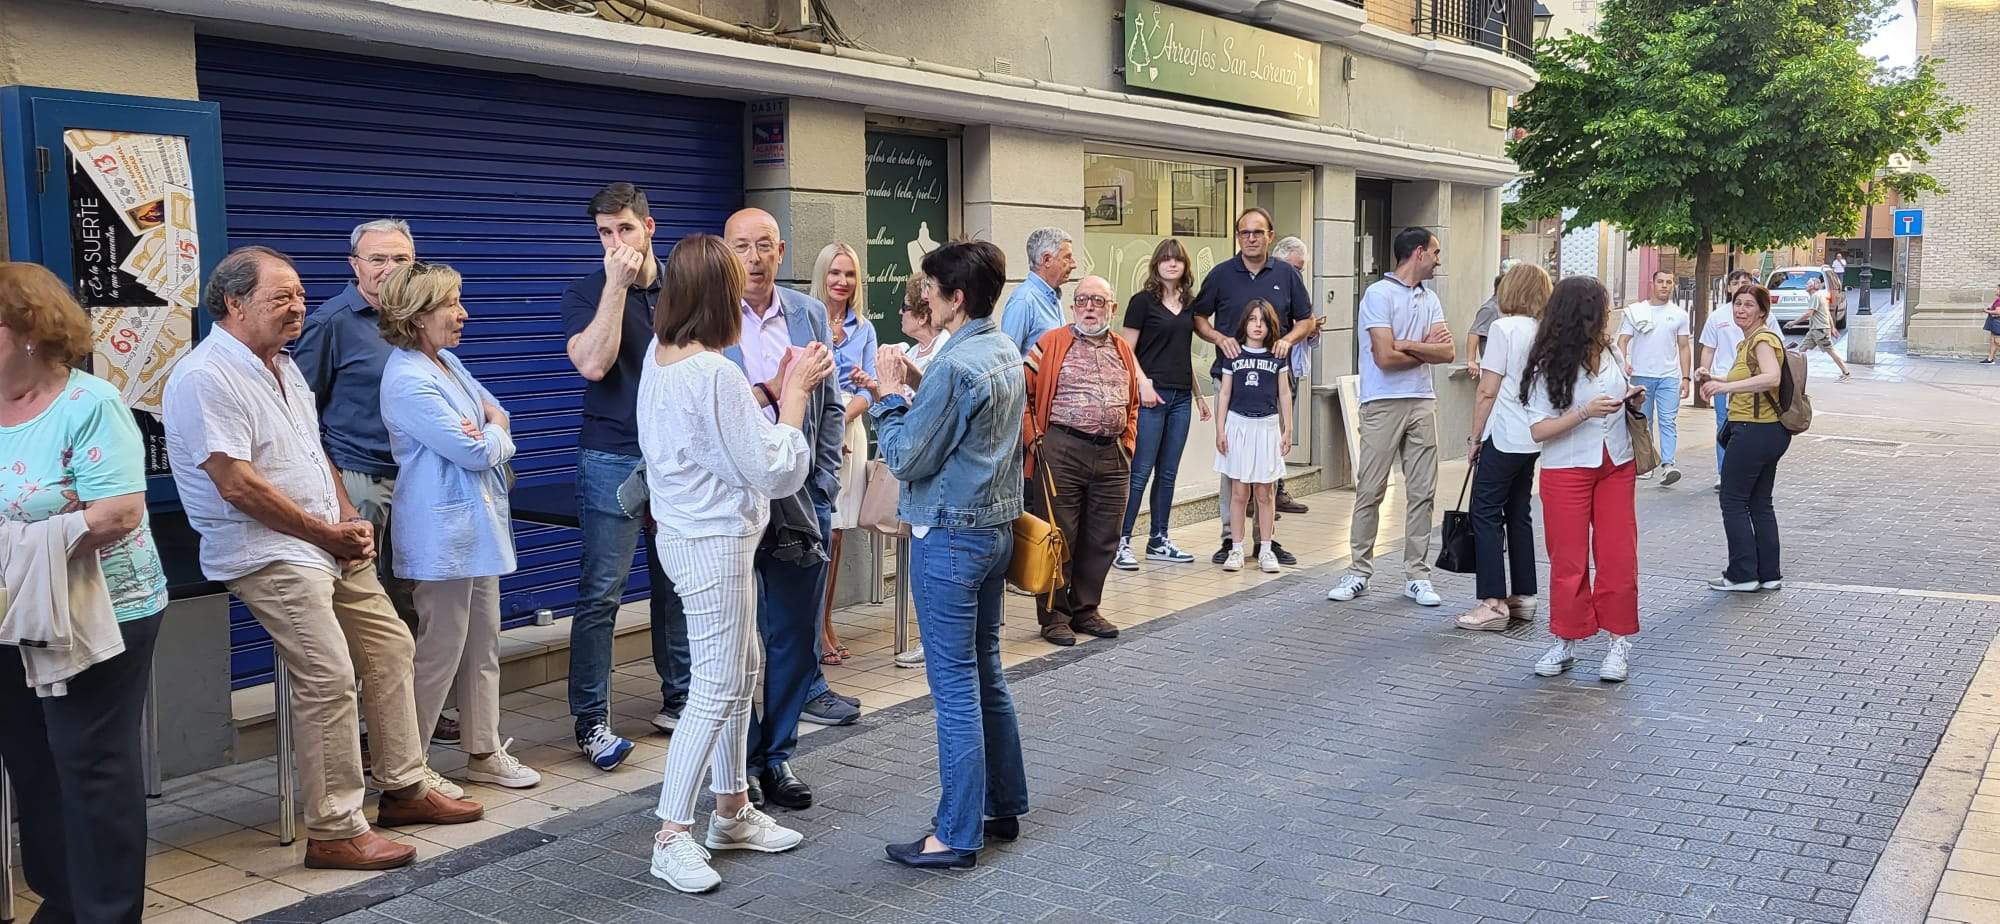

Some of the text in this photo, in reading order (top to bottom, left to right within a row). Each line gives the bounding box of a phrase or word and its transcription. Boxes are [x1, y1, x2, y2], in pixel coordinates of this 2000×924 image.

[1153, 22, 1297, 86] Arreglos San Lorenzo
[92, 154, 119, 175] 13
[865, 140, 934, 181] glos de todo tipo
[866, 181, 892, 198] endas
[894, 177, 914, 201] (tela,
[80, 196, 102, 263] SUERTE
[179, 238, 197, 263] 15
[876, 264, 893, 283] del
[888, 264, 908, 294] hogar
[110, 328, 141, 354] 69
[1232, 358, 1278, 374] OCEAN HILLS
